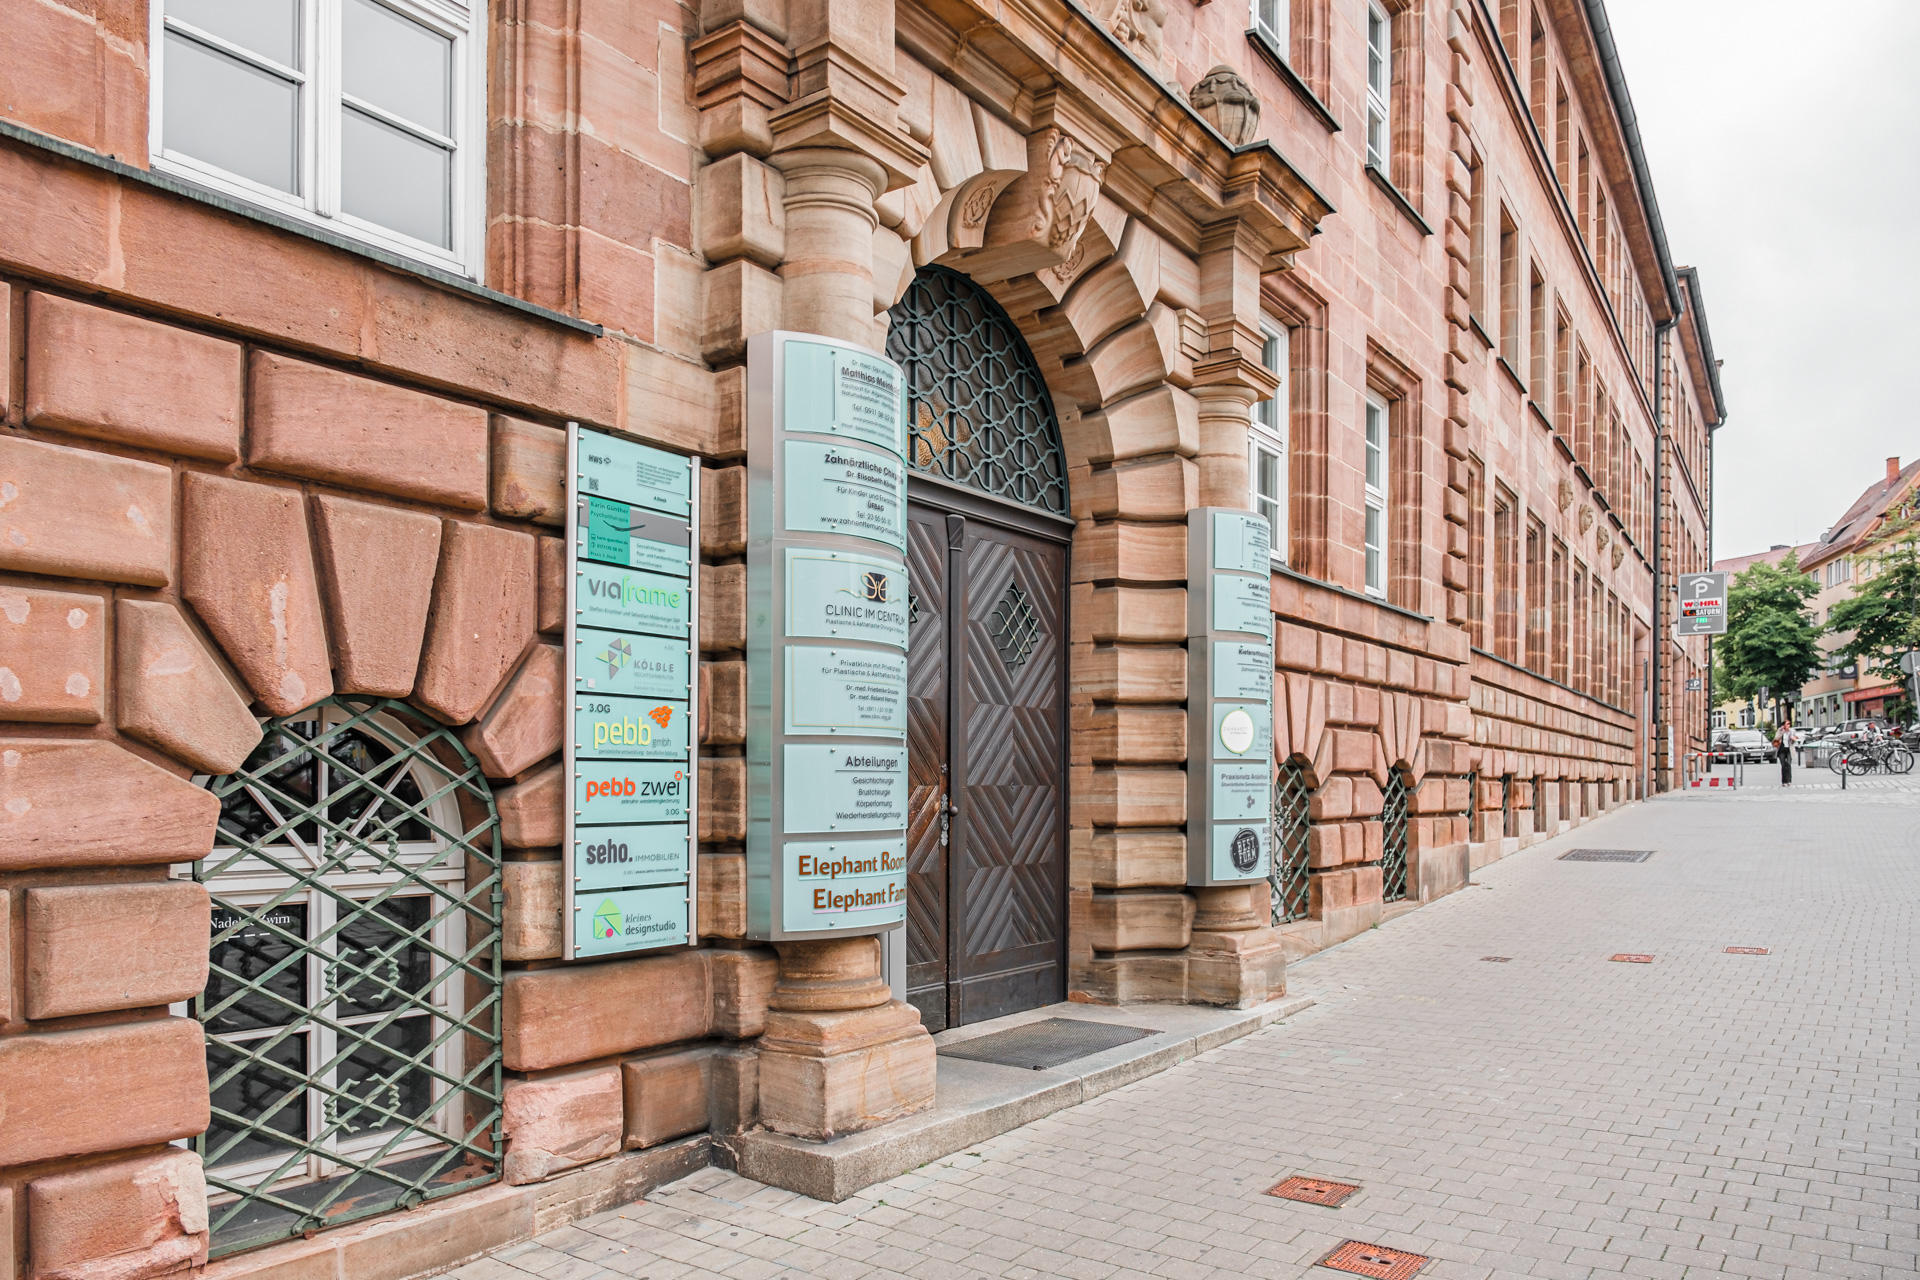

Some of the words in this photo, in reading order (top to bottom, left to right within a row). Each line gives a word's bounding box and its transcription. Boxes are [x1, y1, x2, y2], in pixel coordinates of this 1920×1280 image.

[841, 366, 876, 384] Matthias
[588, 454, 603, 465] HWS
[824, 453, 883, 474] Zahnärztliche
[837, 485, 848, 494] Für
[848, 487, 868, 497] Kinder
[590, 501, 605, 510] Karin
[606, 504, 629, 514] Günther
[589, 575, 681, 608] viaframe
[1695, 583, 1708, 598] P
[826, 604, 863, 618] CLINIC
[865, 608, 876, 619] IM
[1684, 600, 1720, 608] WÖHRL
[1696, 608, 1721, 616] SATURN
[634, 659, 675, 673] KÖLBLE
[840, 660, 872, 668] Privatklinik
[834, 668, 866, 676] Plastische
[589, 703, 611, 714] 3.OG
[594, 715, 652, 750] pebb
[845, 755, 899, 770] Abteilungen
[586, 777, 636, 803] pebb
[641, 770, 683, 796] zwei
[586, 838, 633, 865] seho.
[635, 853, 680, 862] IMMOBILIEN
[1237, 836, 1255, 853] BEST
[798, 855, 878, 880] Elephant
[813, 888, 886, 912] Elephant
[210, 916, 242, 929] Nade
[625, 913, 652, 924] kleines
[625, 920, 677, 936] designstudio
